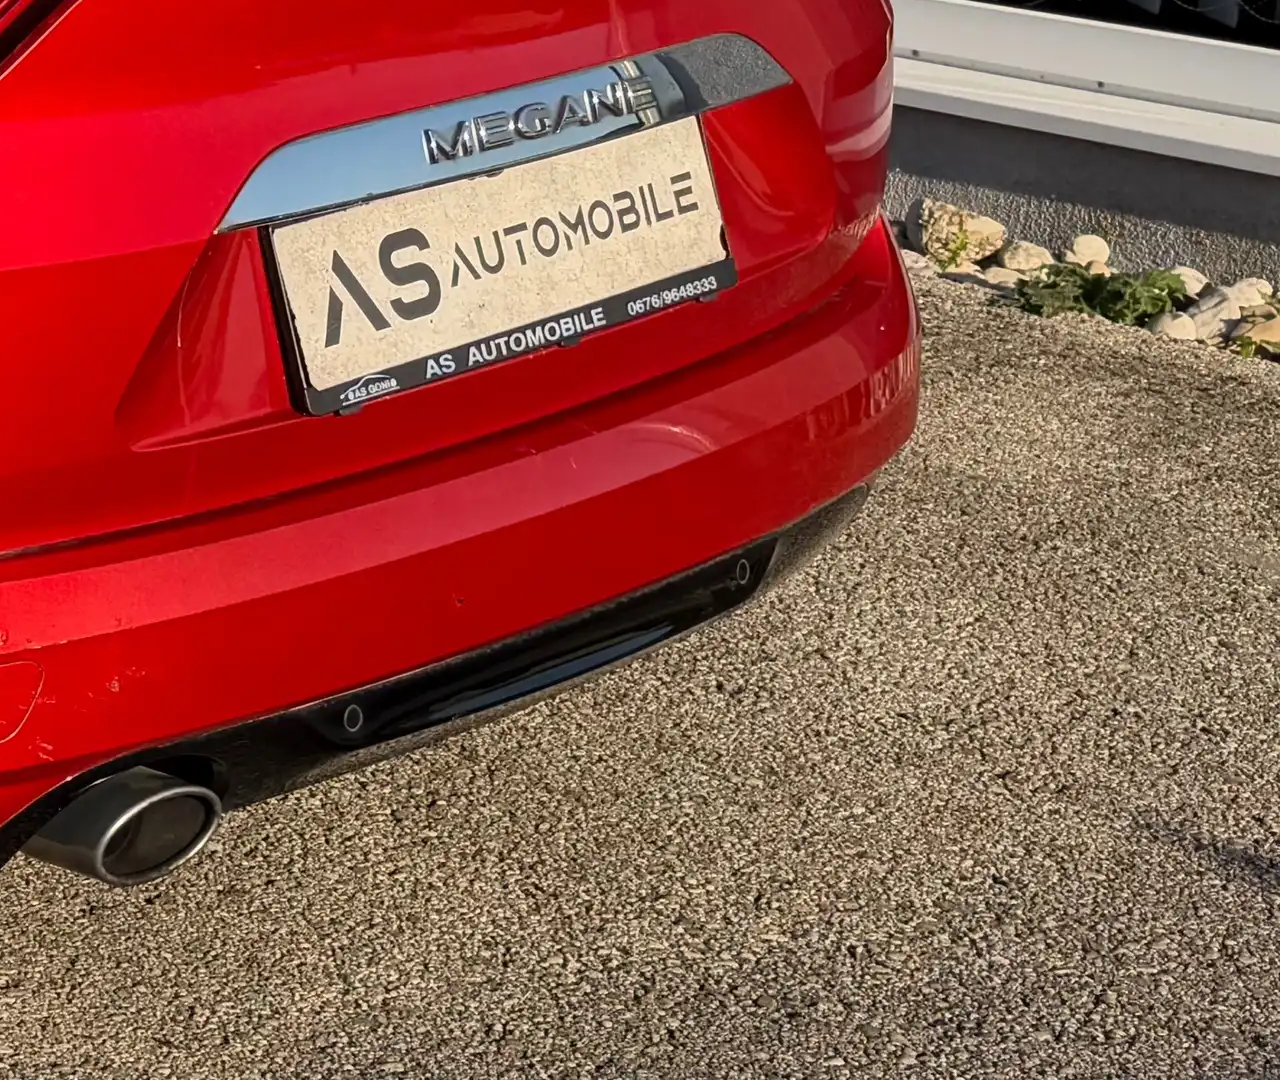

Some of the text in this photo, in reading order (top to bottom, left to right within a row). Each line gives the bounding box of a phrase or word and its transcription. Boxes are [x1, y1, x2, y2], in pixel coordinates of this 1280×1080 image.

[421, 77, 656, 165] MEGANE
[324, 171, 699, 348] AS AUTOMOBILE
[425, 275, 718, 380] AS AUTOMOBILE 0676/9648333
